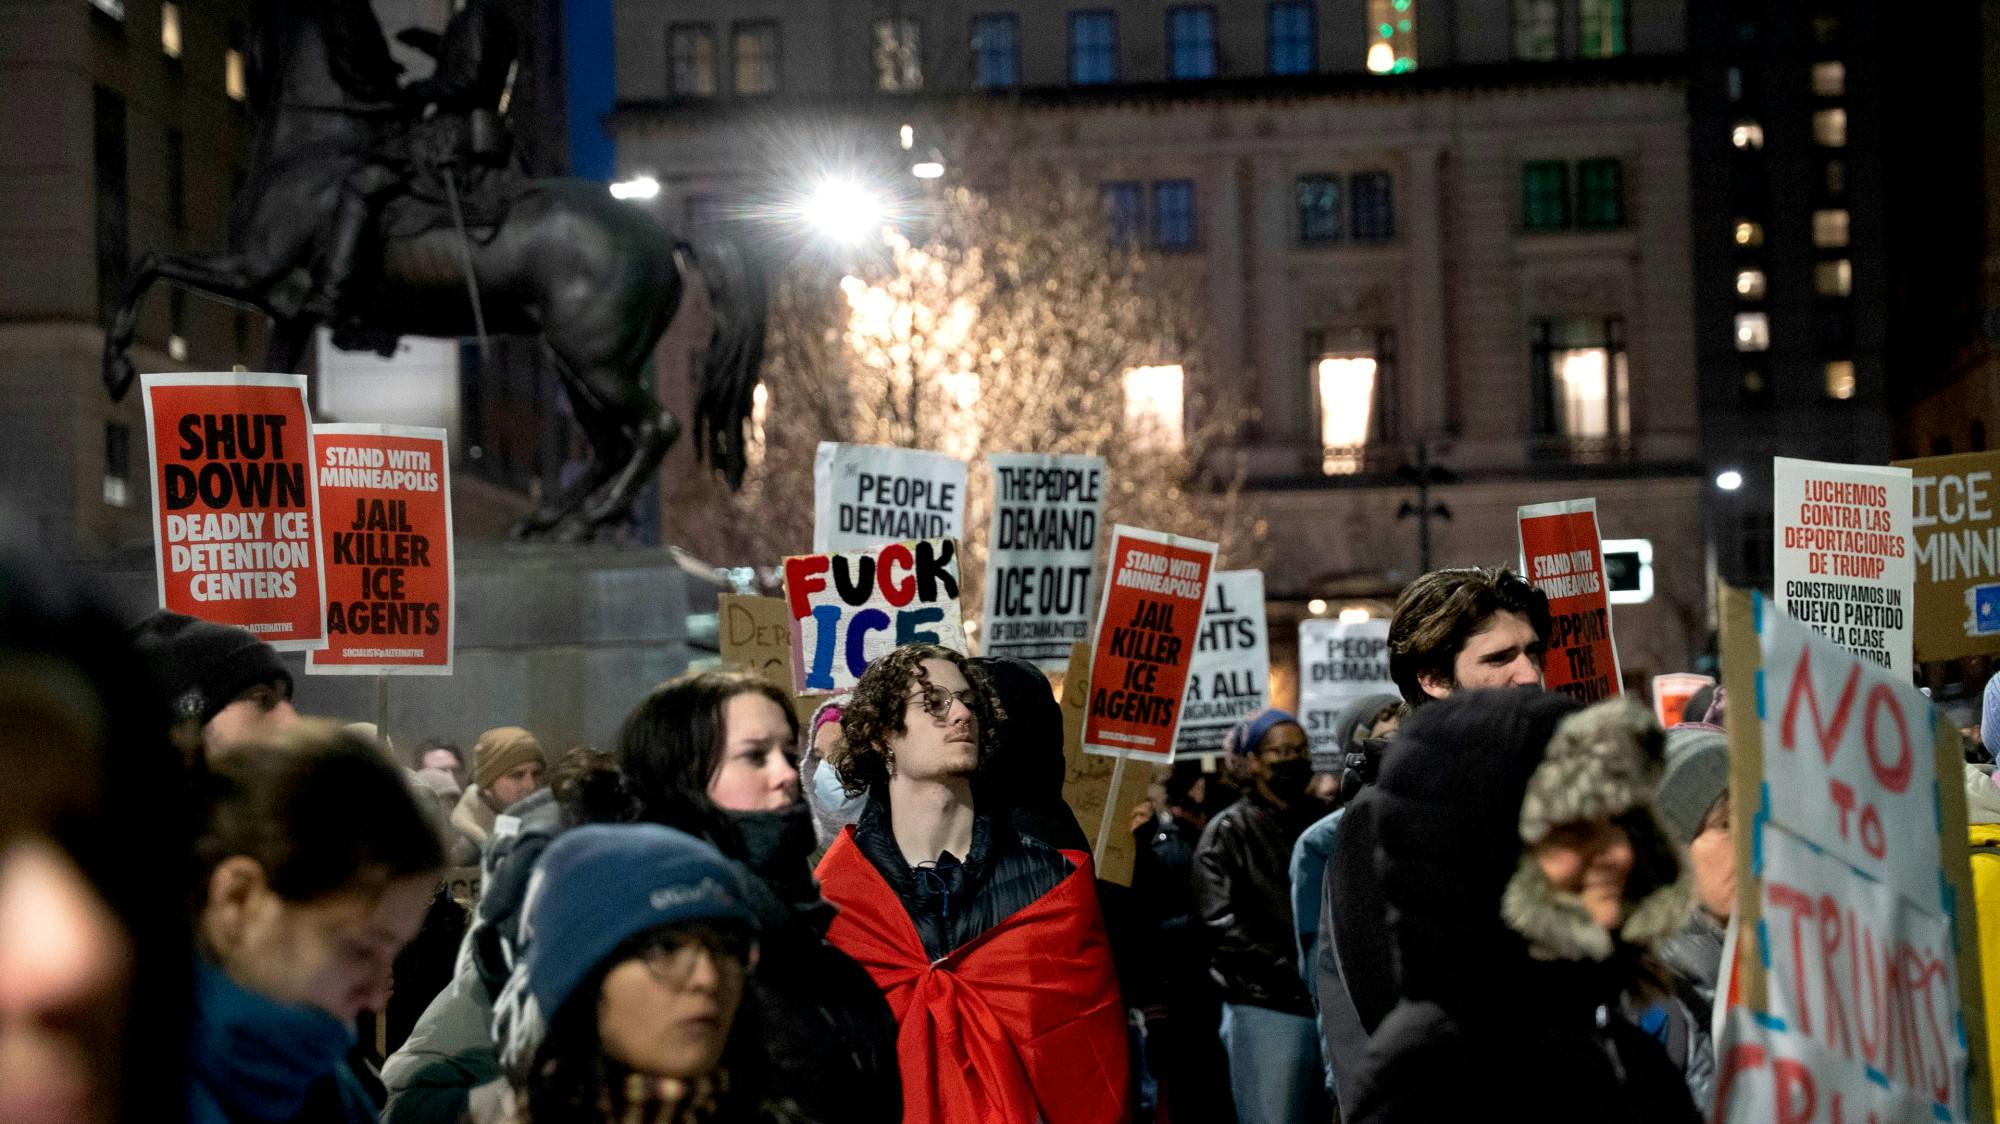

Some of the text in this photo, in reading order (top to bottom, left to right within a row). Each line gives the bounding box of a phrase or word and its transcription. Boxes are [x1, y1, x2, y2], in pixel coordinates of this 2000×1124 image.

[178, 413, 287, 461] SHUT
[326, 447, 431, 471] STAND WITH
[164, 463, 306, 511] DOWN
[320, 467, 439, 492] MINNEAPOLIS
[858, 473, 955, 512] PEOPLE
[999, 467, 1099, 502] THE PEOPLE
[1804, 480, 1887, 508] LUCHEMOS
[351, 498, 412, 533] JAIL
[1912, 471, 1993, 527] ICE
[167, 511, 309, 543] DEADLY ICE
[998, 508, 1095, 550] DEMAND
[1801, 503, 1891, 532] CONTRA LAS
[171, 541, 309, 572] DETENTION
[333, 532, 431, 567] KILLER
[1785, 526, 1905, 559] DEPORTACIONES
[786, 540, 959, 621] FUCK
[1125, 550, 1201, 579] STAND WITH
[1533, 550, 1593, 578] STAND WITH
[1809, 552, 1885, 579] DE TRUMP
[190, 571, 297, 601] CENTERS
[361, 568, 405, 601] ICE
[995, 567, 1091, 616] ICE OUT
[1117, 568, 1202, 599] MINNEAPOLIS
[1786, 580, 1901, 606] CONSTRUYAMOS UN
[327, 601, 440, 636] AGENTS
[728, 603, 792, 646] DEP
[1130, 599, 1174, 634] JAIL
[1550, 608, 1606, 648] UPPORT
[1787, 600, 1903, 630] NUEVO PARTIDO
[1110, 627, 1182, 666] KILLER
[1328, 637, 1386, 658] PEOP
[1831, 626, 1846, 645] LA
[1849, 627, 1885, 649] CLASE
[1123, 661, 1159, 693] ICE
[1312, 662, 1389, 682] DEMAN
[1566, 645, 1597, 680] THE
[1213, 671, 1261, 699] ALL
[1092, 688, 1175, 727] AGENTS
[1780, 641, 1913, 794] NO
[1829, 777, 1886, 860] TO
